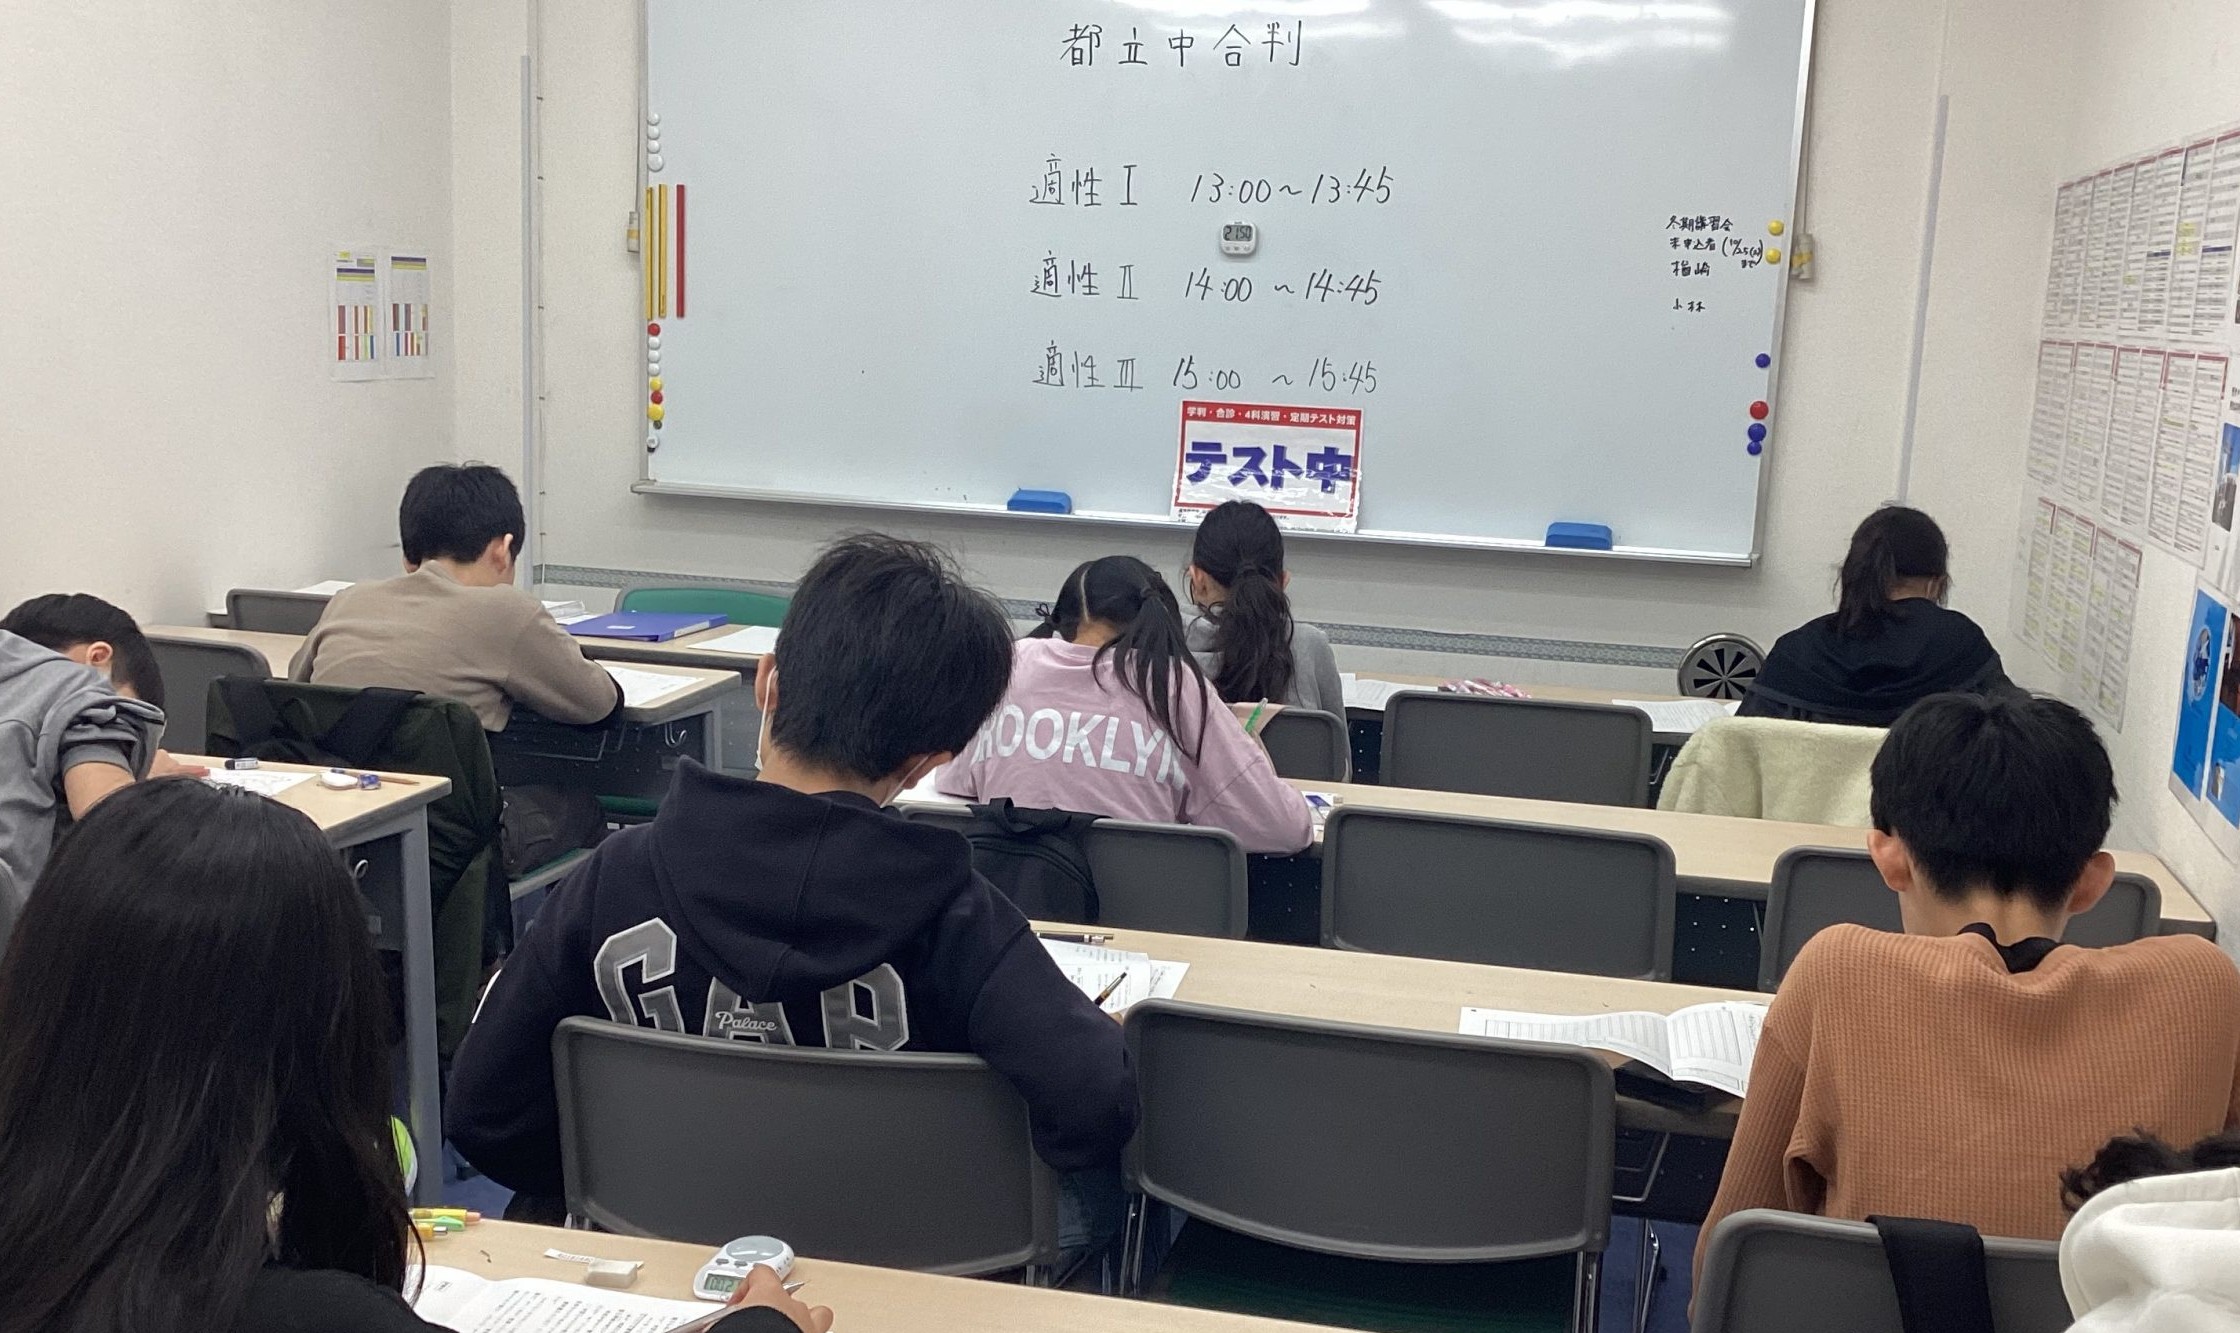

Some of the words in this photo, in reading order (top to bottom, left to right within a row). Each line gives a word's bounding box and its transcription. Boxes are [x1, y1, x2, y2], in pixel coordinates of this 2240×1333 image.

[1060, 20, 1302, 66] 都立中合判
[1186, 441, 1354, 494] テスト中
[715, 1011, 777, 1031] Palace
